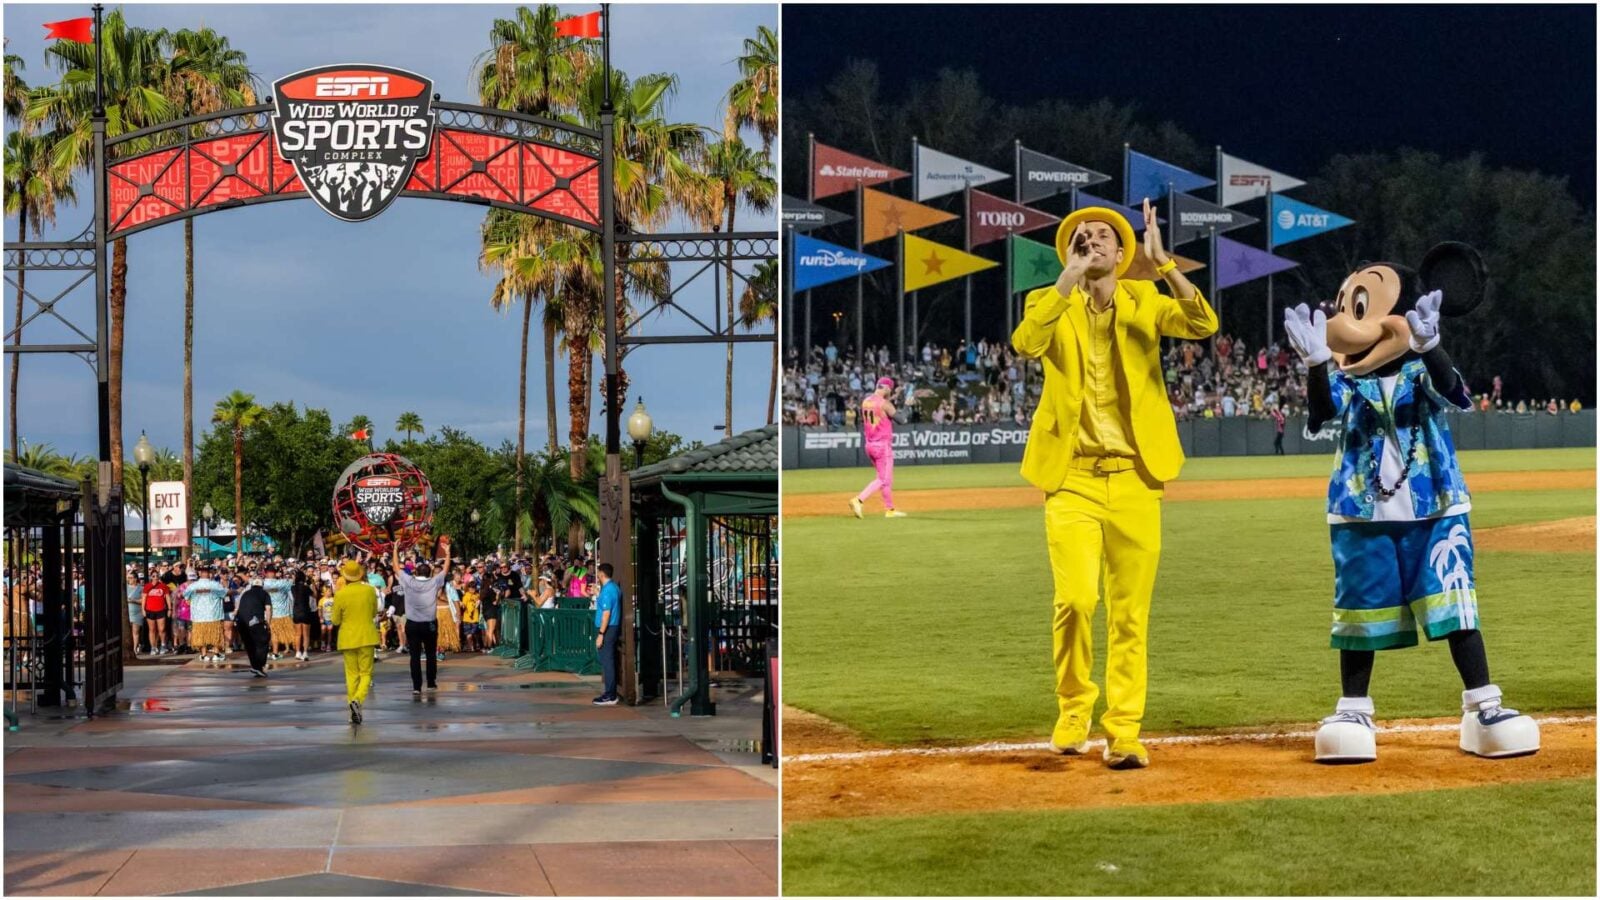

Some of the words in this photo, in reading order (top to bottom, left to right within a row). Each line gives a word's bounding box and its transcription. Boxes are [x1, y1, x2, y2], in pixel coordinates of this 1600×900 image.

[316, 76, 389, 97] ESPN
[288, 103, 335, 118] WIDE
[337, 102, 398, 118] WORLD
[400, 105, 419, 117] OF
[281, 119, 428, 151] SPORTS
[324, 151, 382, 160] COMPLEX
[447, 167, 540, 188] CORKSCRW
[1028, 170, 1089, 183] POWERADE
[1230, 174, 1271, 186] ESPN
[976, 211, 1025, 226] TORO
[1180, 212, 1233, 223] BODYARMOR
[1297, 214, 1329, 227] AT&T
[805, 432, 861, 449] ESPN
[891, 432, 910, 447] DE
[911, 430, 970, 446] WORLD
[972, 432, 989, 445] OF
[991, 428, 1030, 444] SPOR
[155, 493, 180, 508] EXIT
[356, 492, 403, 503] SPORTS
